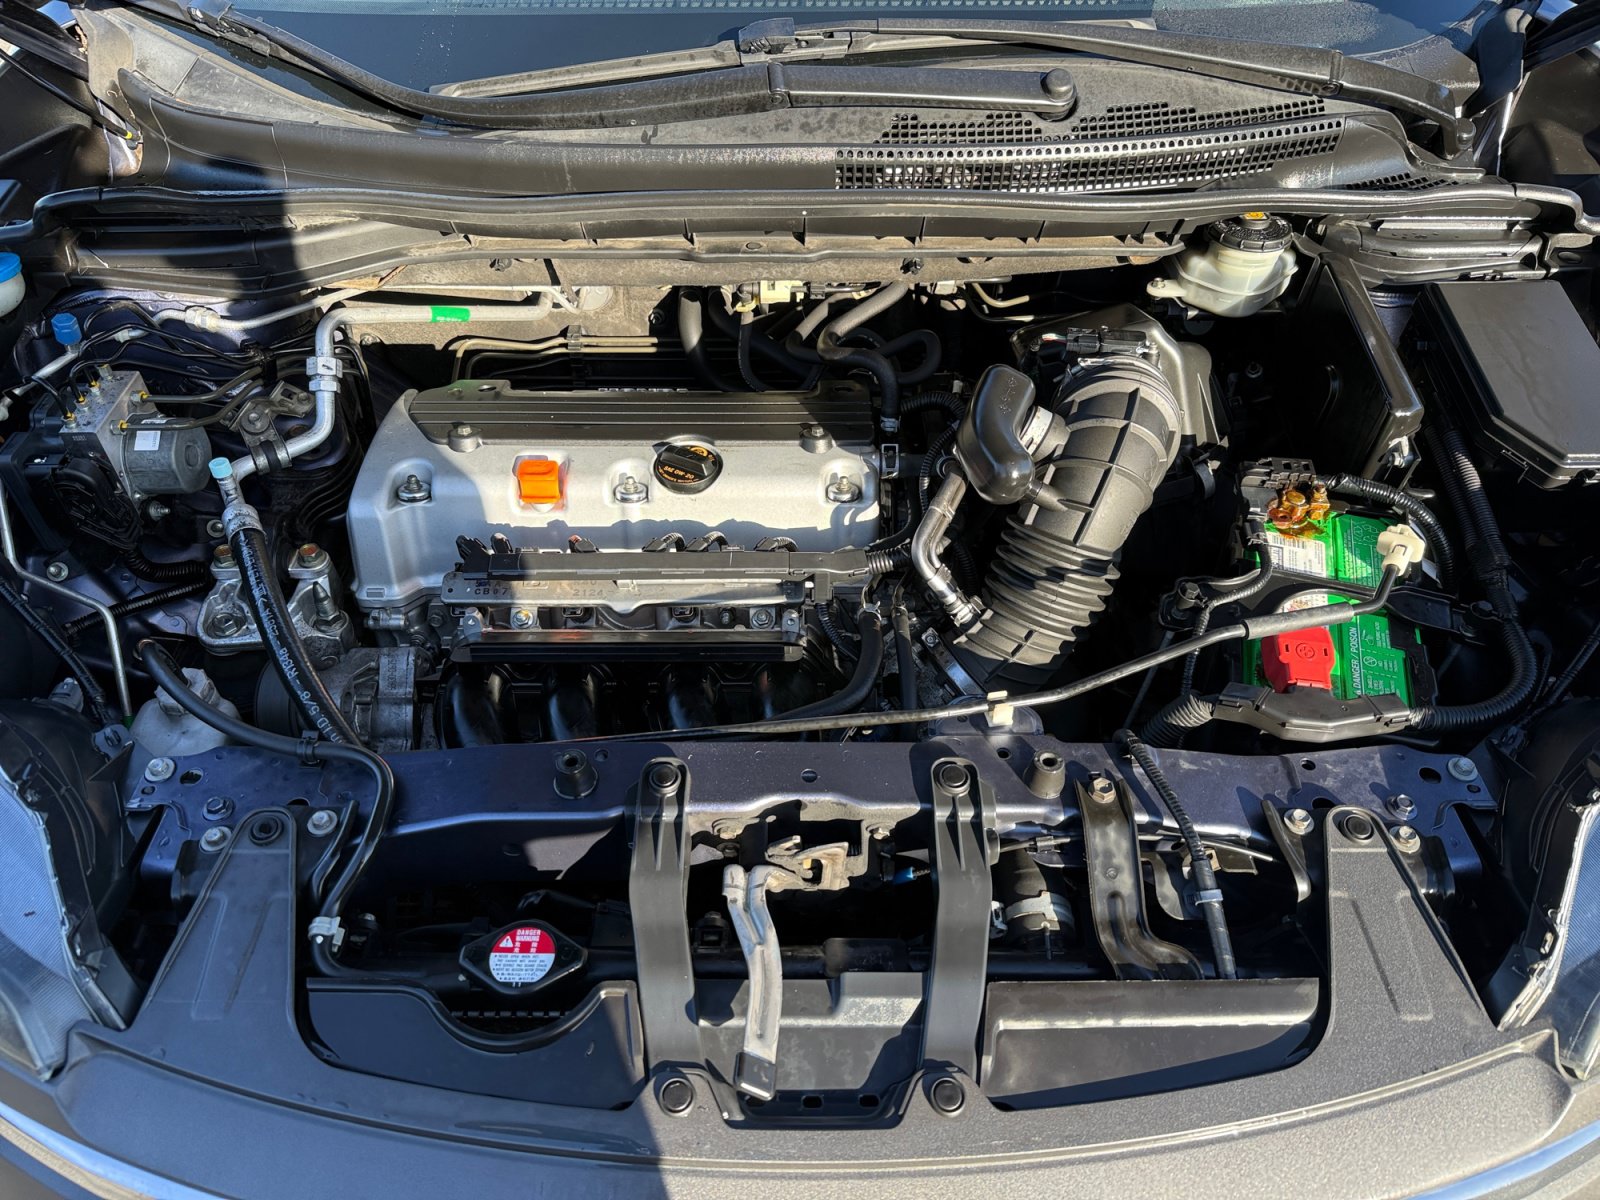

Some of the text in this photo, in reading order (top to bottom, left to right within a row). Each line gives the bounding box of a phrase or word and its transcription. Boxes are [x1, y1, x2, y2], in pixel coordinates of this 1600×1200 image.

[1349, 627, 1358, 653] POISON
[278, 647, 299, 679] R134a
[1351, 659, 1361, 688] DANGER
[314, 713, 333, 735] I.D.
